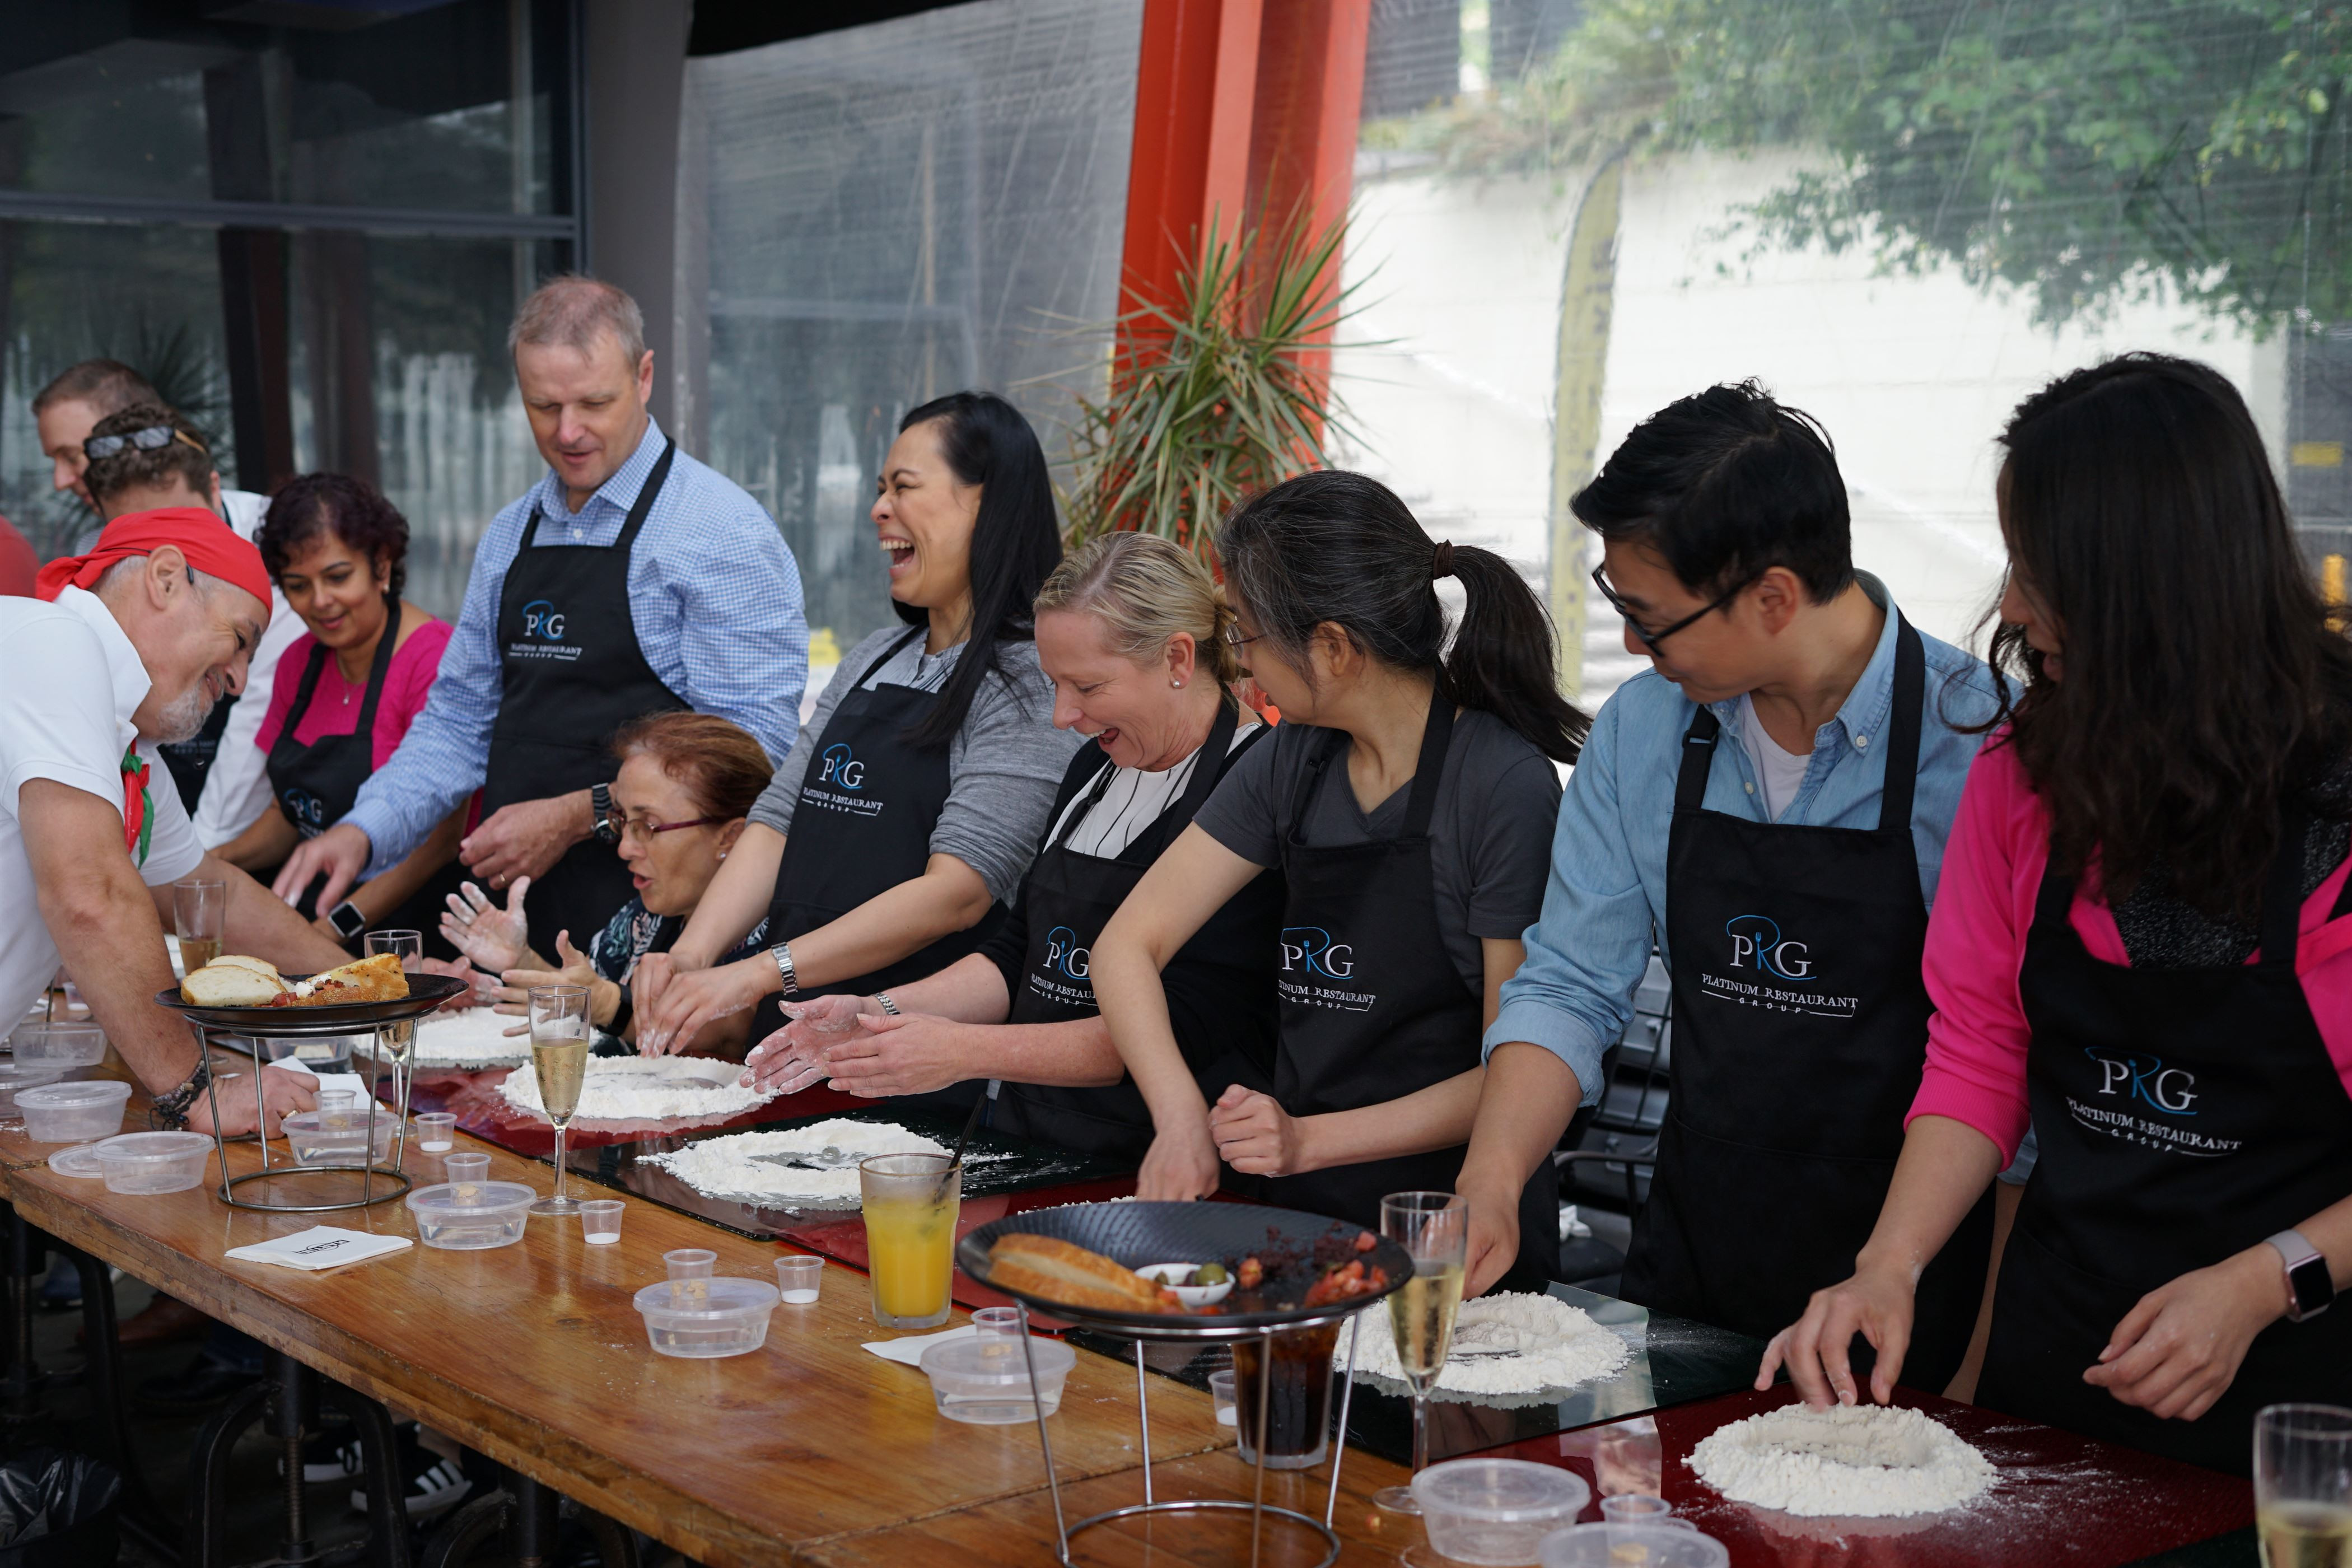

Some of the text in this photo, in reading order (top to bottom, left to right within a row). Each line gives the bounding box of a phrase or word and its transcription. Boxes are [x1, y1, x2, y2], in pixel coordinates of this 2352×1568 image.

[522, 600, 565, 640] PRG
[819, 743, 865, 789] PRG
[832, 794, 883, 810] RESTAURANT
[1043, 926, 1091, 979] PRG
[1280, 927, 1354, 979] PRG
[1726, 914, 1817, 980] PRG
[1057, 984, 1096, 998] RESTAU
[1278, 979, 1376, 1004] TINUM RESTAURANT
[1291, 997, 1341, 1009] GROUP
[1702, 973, 1858, 1008] PLATINUM RESTAURANT
[1739, 997, 1801, 1014] GROUP
[2084, 1046, 2198, 1115] PRG
[2066, 1096, 2242, 1150] PLATINUM RESTAURANT
